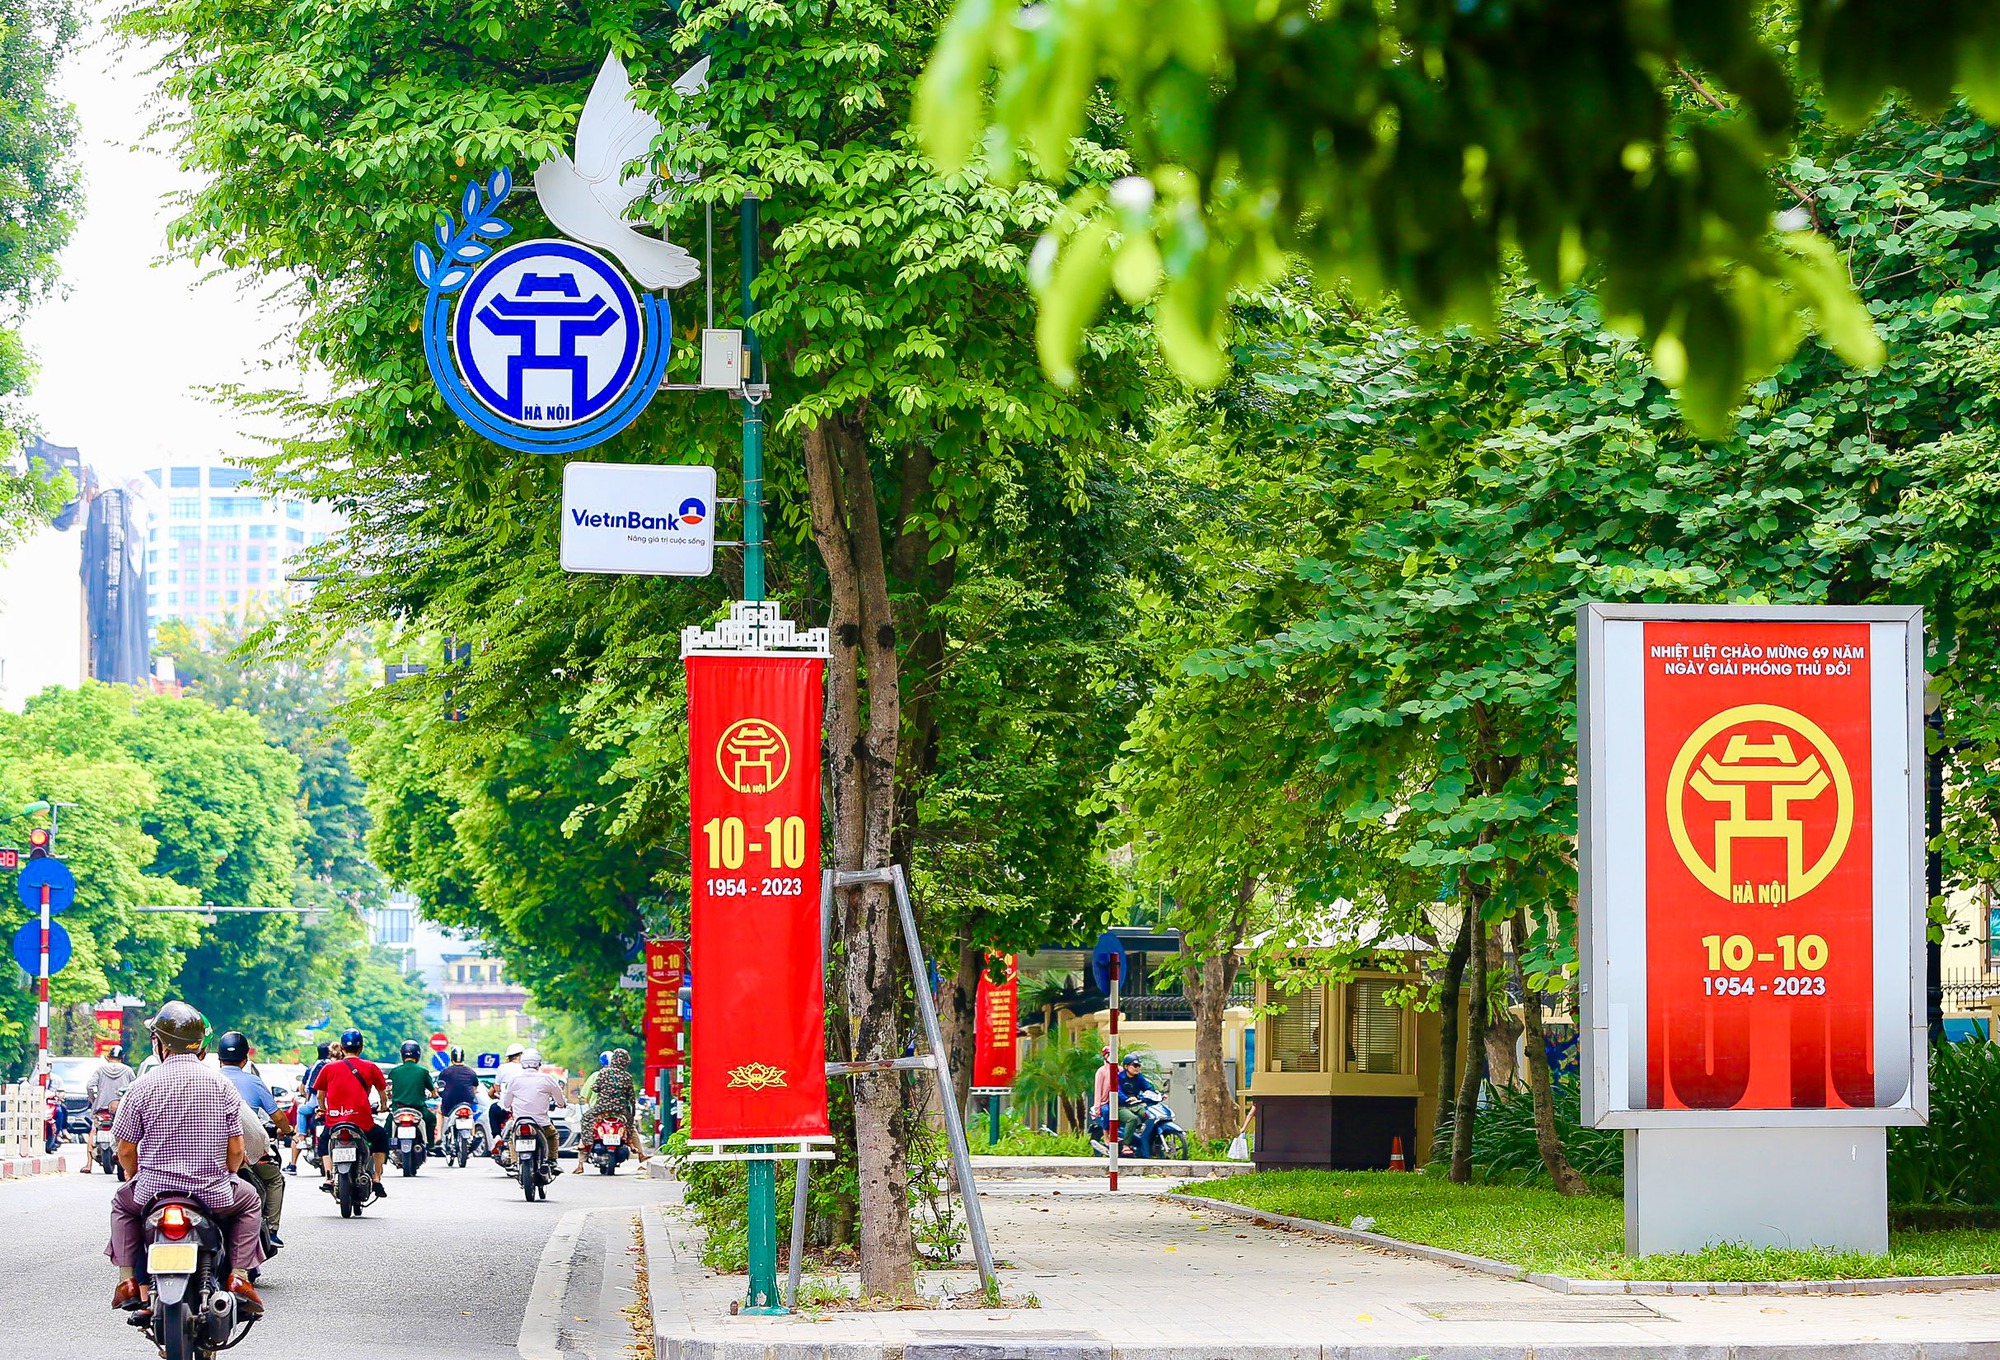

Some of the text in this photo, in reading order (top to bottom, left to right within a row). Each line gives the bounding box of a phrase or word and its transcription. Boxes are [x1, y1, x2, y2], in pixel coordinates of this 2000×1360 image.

[524, 403, 570, 424] HÀ NỘI
[571, 508, 680, 531] VietinBank
[669, 537, 687, 545] cuộc
[688, 538, 706, 546] sống
[1651, 643, 1865, 661] NHIỆT LIỆT CHÀO MỪNG 69 NĂM
[1665, 659, 1851, 675] NGÀY GIẢI PHÓNG THỦ ĐÔ!
[741, 783, 766, 795] HÀ NỘI
[703, 816, 805, 870] 10-10
[707, 879, 747, 896] 1954
[761, 878, 802, 896] 2023
[1732, 880, 1786, 908] HÀ NỘI
[1701, 934, 1829, 971] 10-10
[651, 954, 680, 970] 10-10
[1703, 977, 1755, 995] 1954
[1773, 976, 1826, 995] 2023
